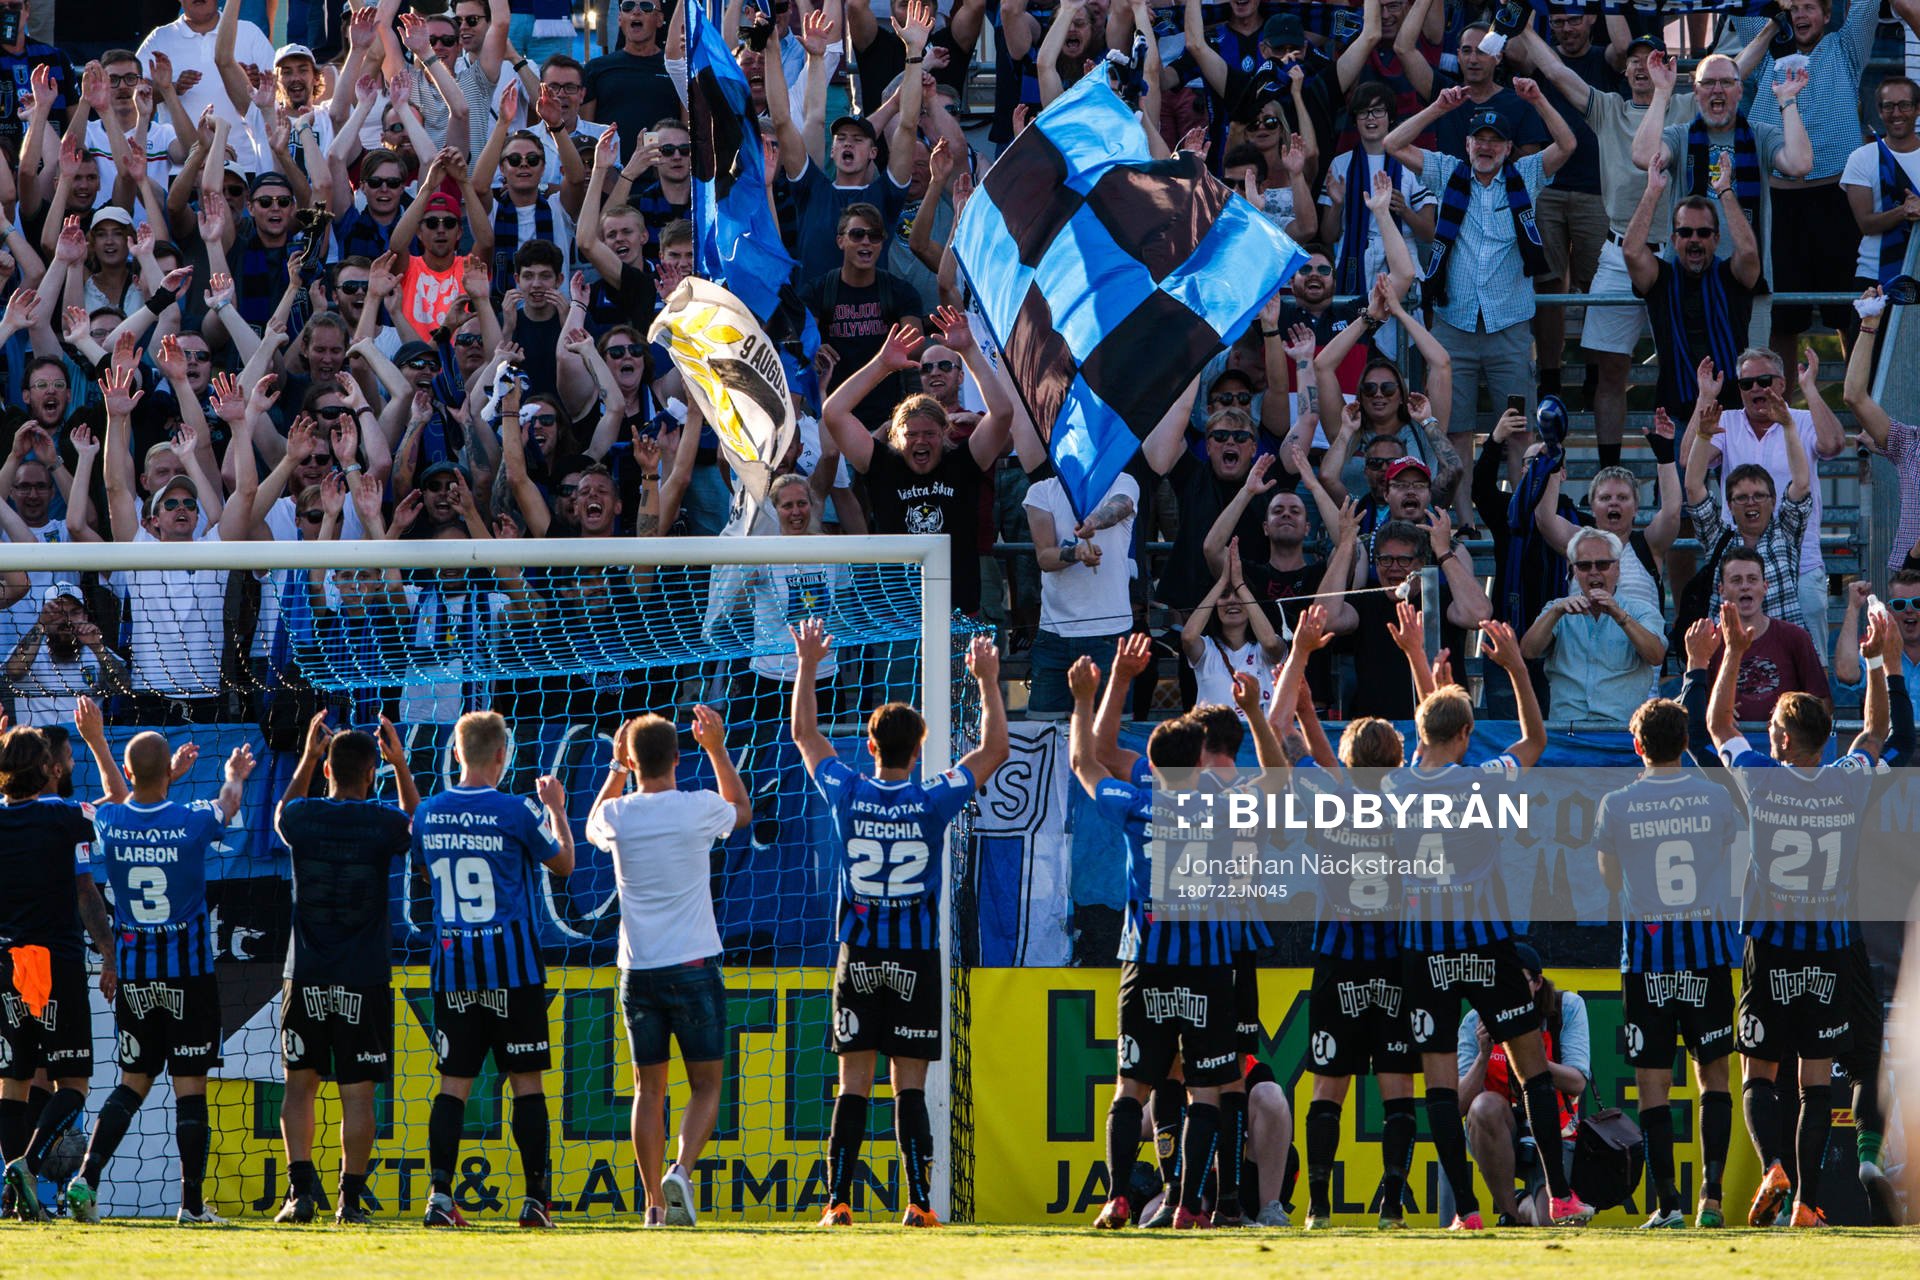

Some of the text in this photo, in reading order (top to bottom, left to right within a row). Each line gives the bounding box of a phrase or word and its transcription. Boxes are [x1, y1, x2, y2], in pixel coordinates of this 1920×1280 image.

[739, 334, 788, 406] 9 AUGUS
[902, 802, 924, 814] TAK
[1627, 795, 1710, 813] ÅRSTA TAK
[1753, 805, 1855, 828] ÅHMAN PERSSON
[1765, 790, 1844, 807] ÅRSTA TAK
[164, 828, 187, 840] TAK
[425, 811, 498, 825] ÅRSTA TAK
[854, 820, 923, 839] VECCHIA
[1143, 822, 1214, 840] SIRELIUS
[1629, 815, 1712, 840] EISWOHLD
[115, 846, 178, 863] LARSON
[423, 833, 503, 852] GUSTAFSSON
[1416, 833, 1456, 885] 4
[1768, 829, 1841, 891] 21
[847, 838, 930, 897] 22
[1142, 840, 1212, 901] 14
[1349, 852, 1390, 909] 8
[1655, 840, 1697, 906] 6
[127, 866, 170, 924] 3
[430, 857, 497, 923] 19
[850, 961, 917, 1002] bjerking
[1428, 953, 1496, 991] bjerking
[1645, 970, 1708, 1007] bjerking
[1769, 966, 1837, 1005] bjerking
[1142, 986, 1208, 1028] bjerking
[506, 1041, 534, 1055] ÖJTE
[894, 1026, 925, 1040] LÖJTE
[76, 1048, 90, 1058] AB
[453, 1156, 503, 1212] &
